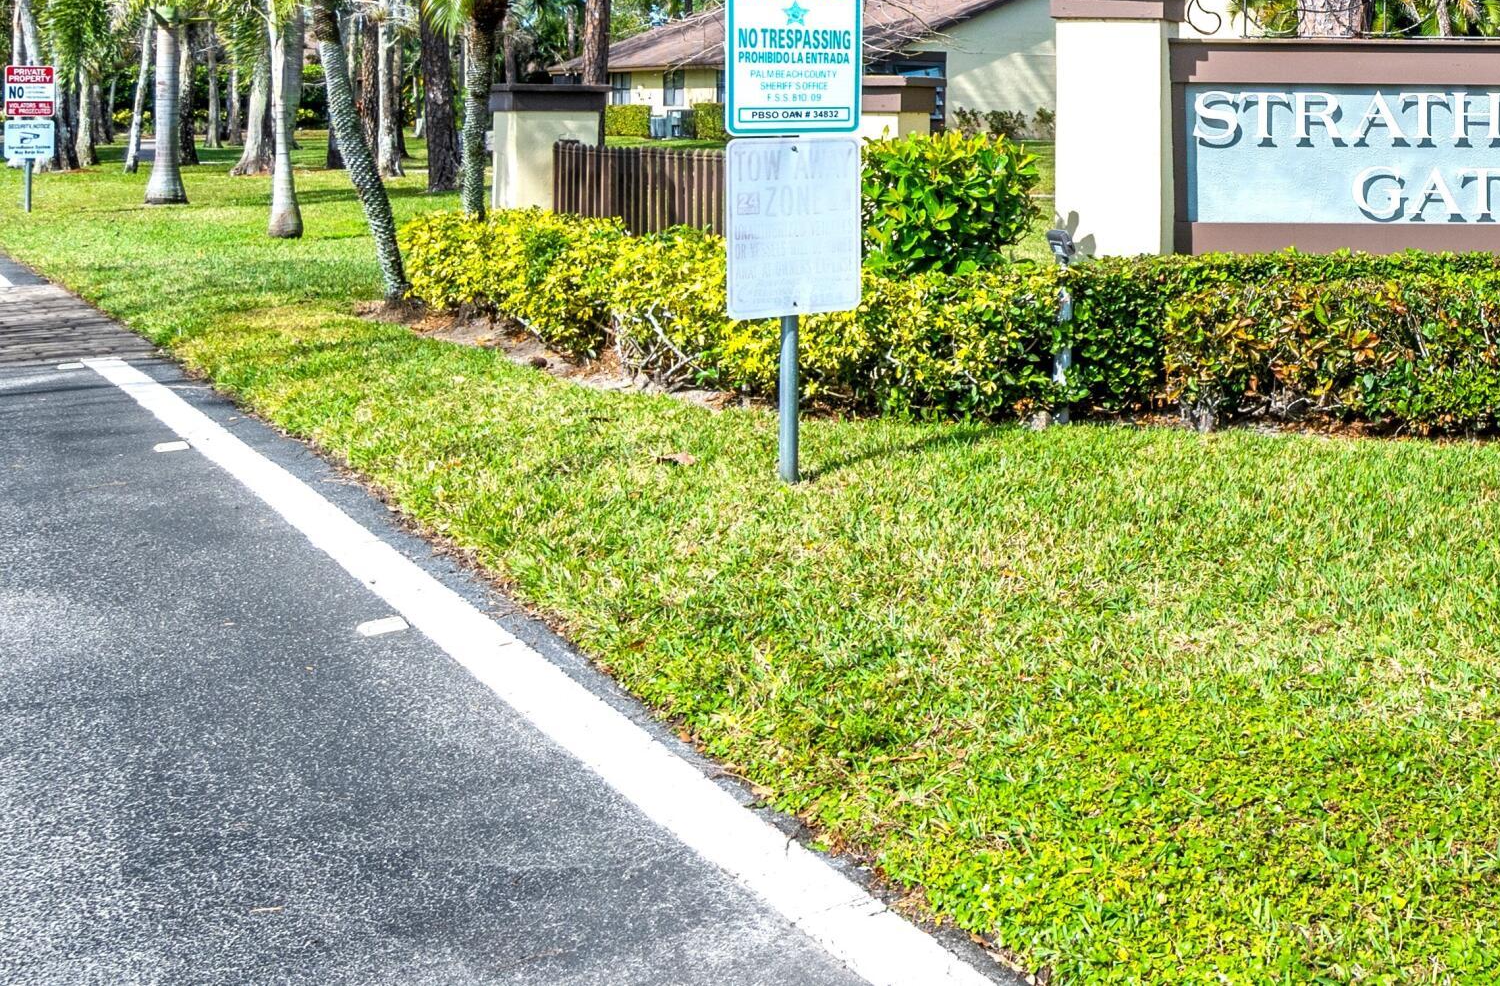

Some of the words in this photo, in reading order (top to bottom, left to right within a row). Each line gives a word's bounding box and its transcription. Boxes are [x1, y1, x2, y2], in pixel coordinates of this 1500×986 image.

[738, 28, 758, 49] NO
[760, 28, 851, 50] TRESPASSING
[738, 51, 790, 63] PROHIBIDO
[791, 52, 804, 64] LA
[805, 52, 850, 64] ENTRADA
[13, 68, 47, 76] PRIVATE
[750, 69, 775, 78] PALM
[775, 69, 803, 78] BEACH
[803, 69, 837, 78] COUNTY
[760, 81, 801, 90] SHERIFF'S
[802, 81, 829, 90] OFFICE
[9, 86, 24, 99] NO
[751, 111, 779, 119] PBSO
[813, 110, 839, 118] 34832
[734, 149, 782, 182] TOW
[738, 193, 759, 208] 24
